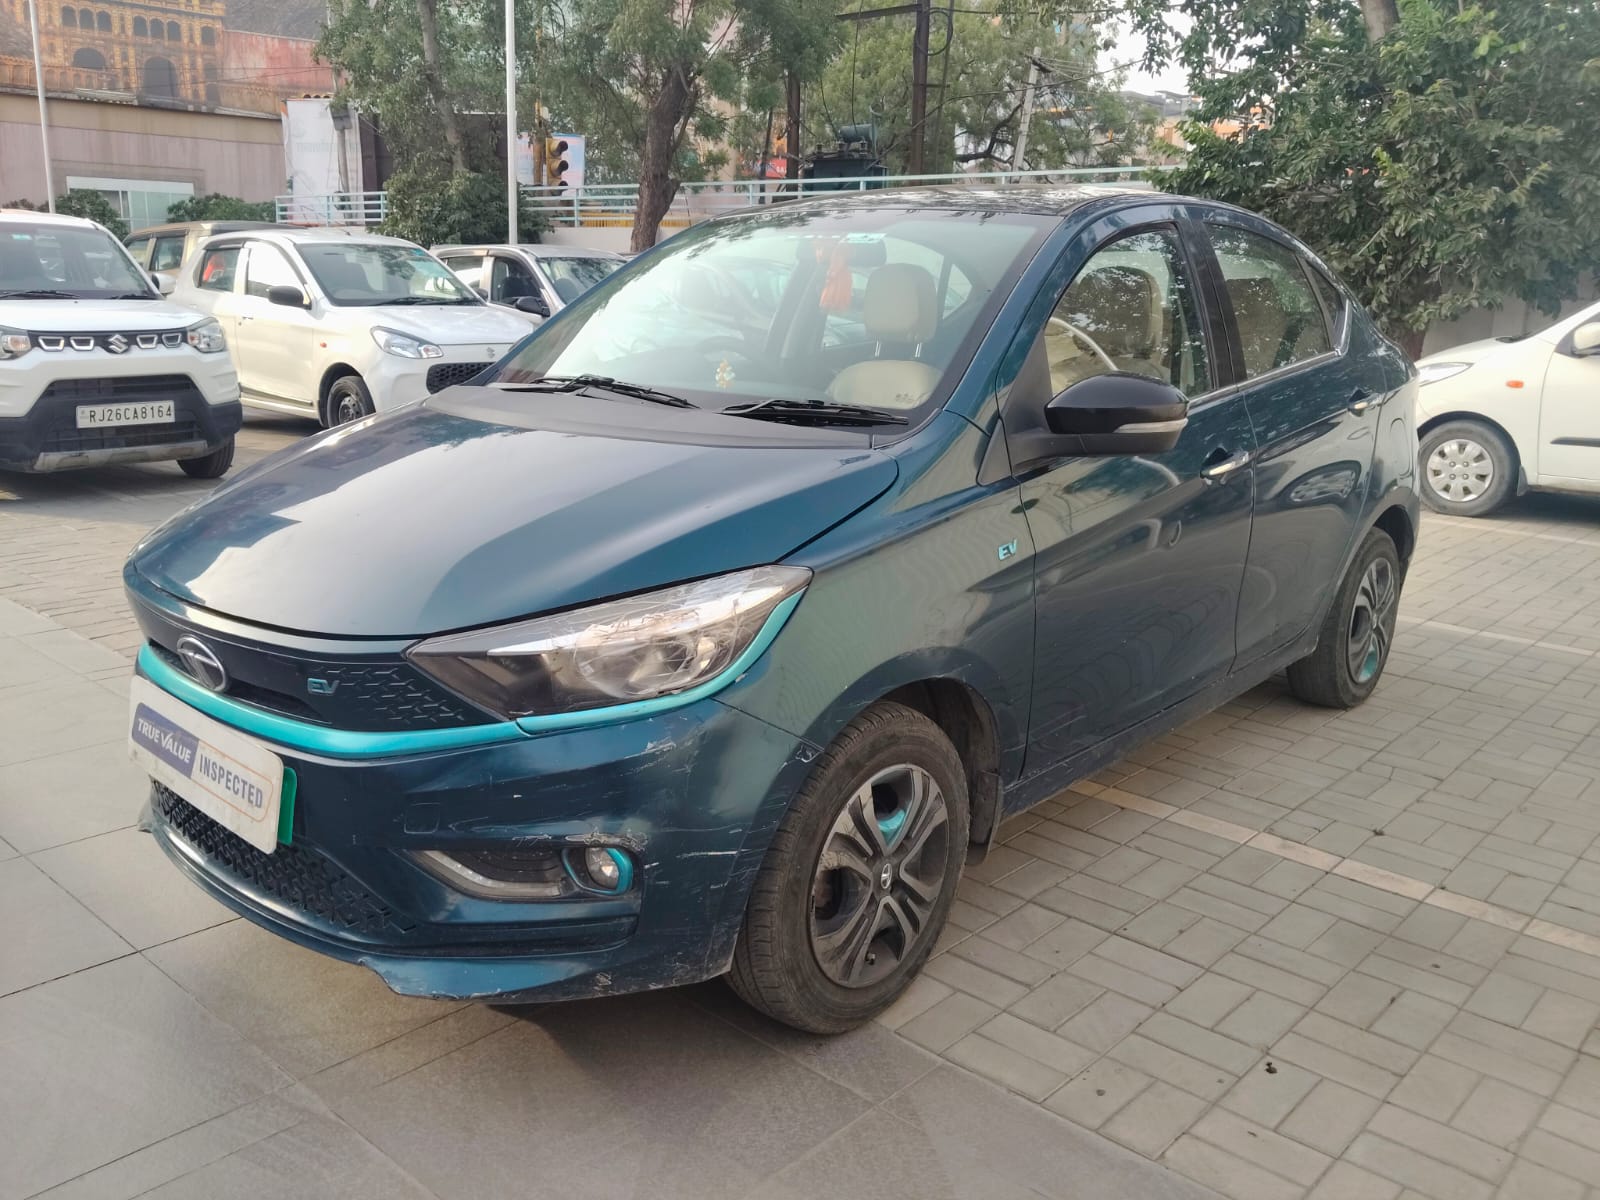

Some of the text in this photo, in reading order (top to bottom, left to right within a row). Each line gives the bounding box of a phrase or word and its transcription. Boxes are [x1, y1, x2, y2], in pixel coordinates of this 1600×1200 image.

[89, 405, 172, 423] RJ26CA8164
[998, 539, 1017, 561] EV
[307, 677, 340, 695] EV
[137, 719, 264, 809] TRUE VALUE INSPECTED
